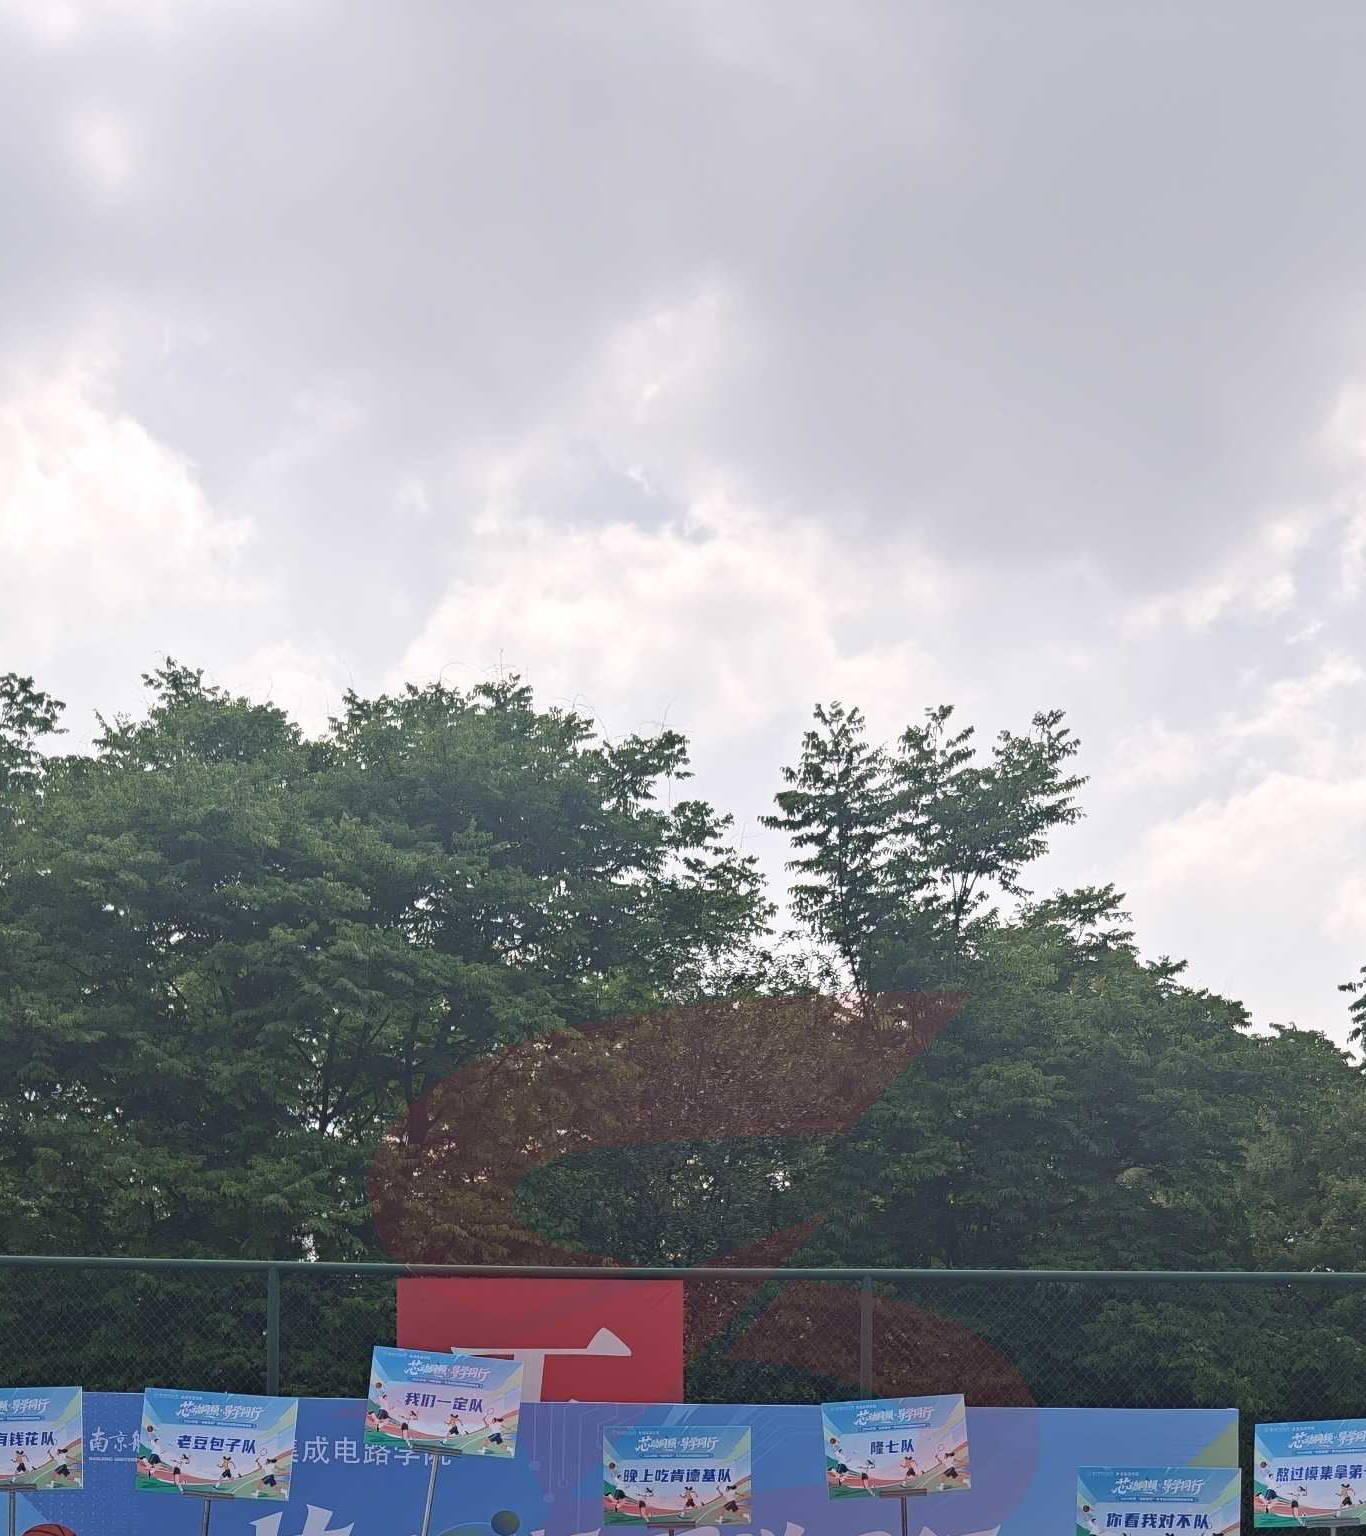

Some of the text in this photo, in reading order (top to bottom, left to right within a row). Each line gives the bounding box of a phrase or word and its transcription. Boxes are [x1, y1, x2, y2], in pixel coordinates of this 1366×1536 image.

[404, 1391, 484, 1414] 我们一定队
[176, 1433, 257, 1456] 老豆包子队
[870, 1438, 915, 1456] 隆七队
[622, 1467, 732, 1484] 晚上吃肯德基队
[1106, 1512, 1210, 1529] 你看我对不队
